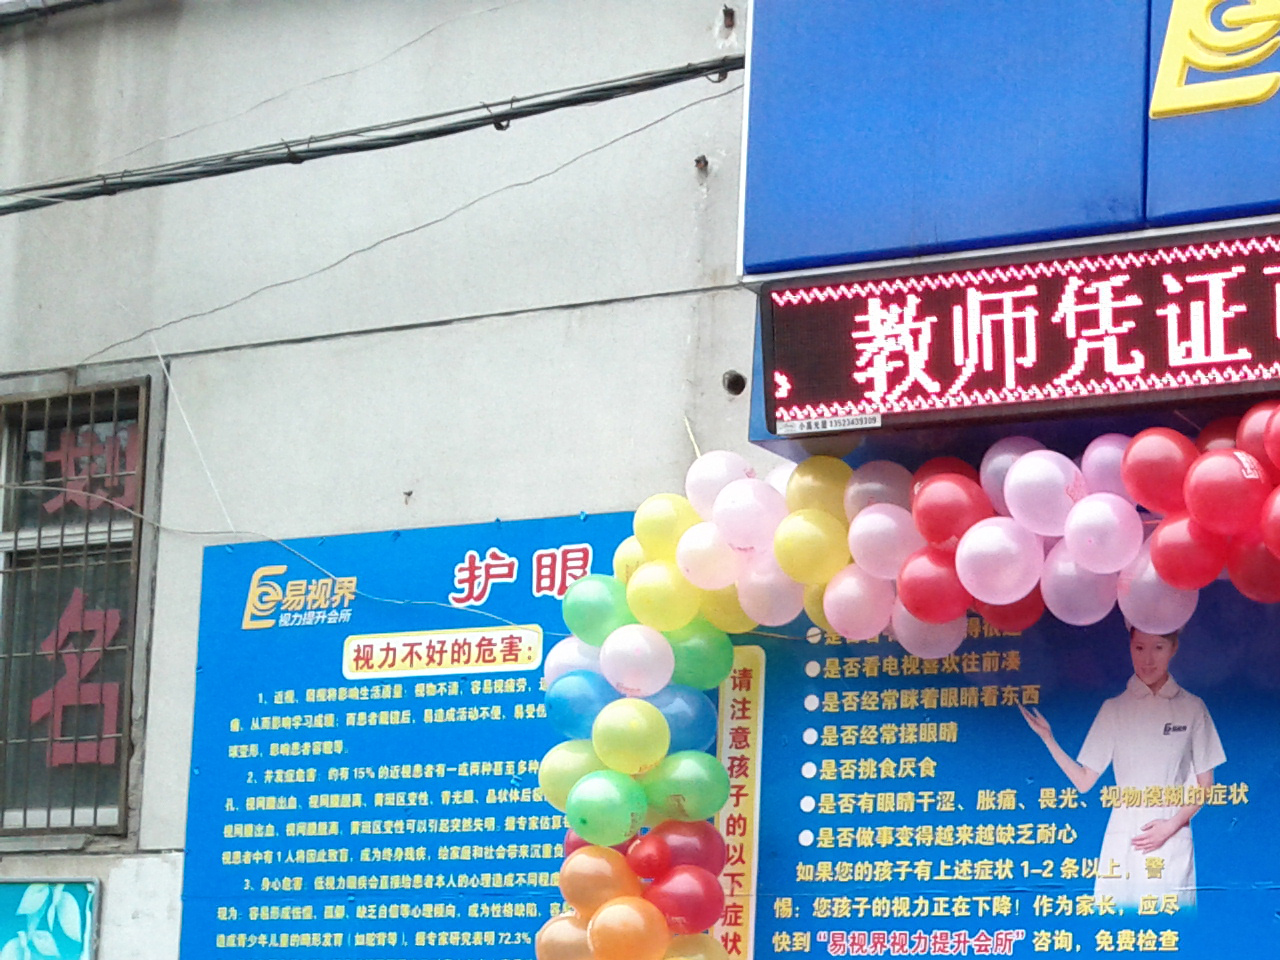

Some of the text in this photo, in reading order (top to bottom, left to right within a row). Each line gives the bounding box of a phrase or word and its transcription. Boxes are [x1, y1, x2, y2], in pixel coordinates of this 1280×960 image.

[449, 544, 591, 605] 护眼
[280, 576, 357, 611] 易视界
[278, 609, 352, 628] 视力提升会所
[30, 587, 121, 767] 名
[821, 721, 957, 746] 是否经常揉眼睛
[819, 757, 937, 780] 是否挑食厌食
[721, 667, 753, 957] 请注意孩子的以下症状
[816, 823, 1077, 848] 是否做事变得越来越缺乏耐心
